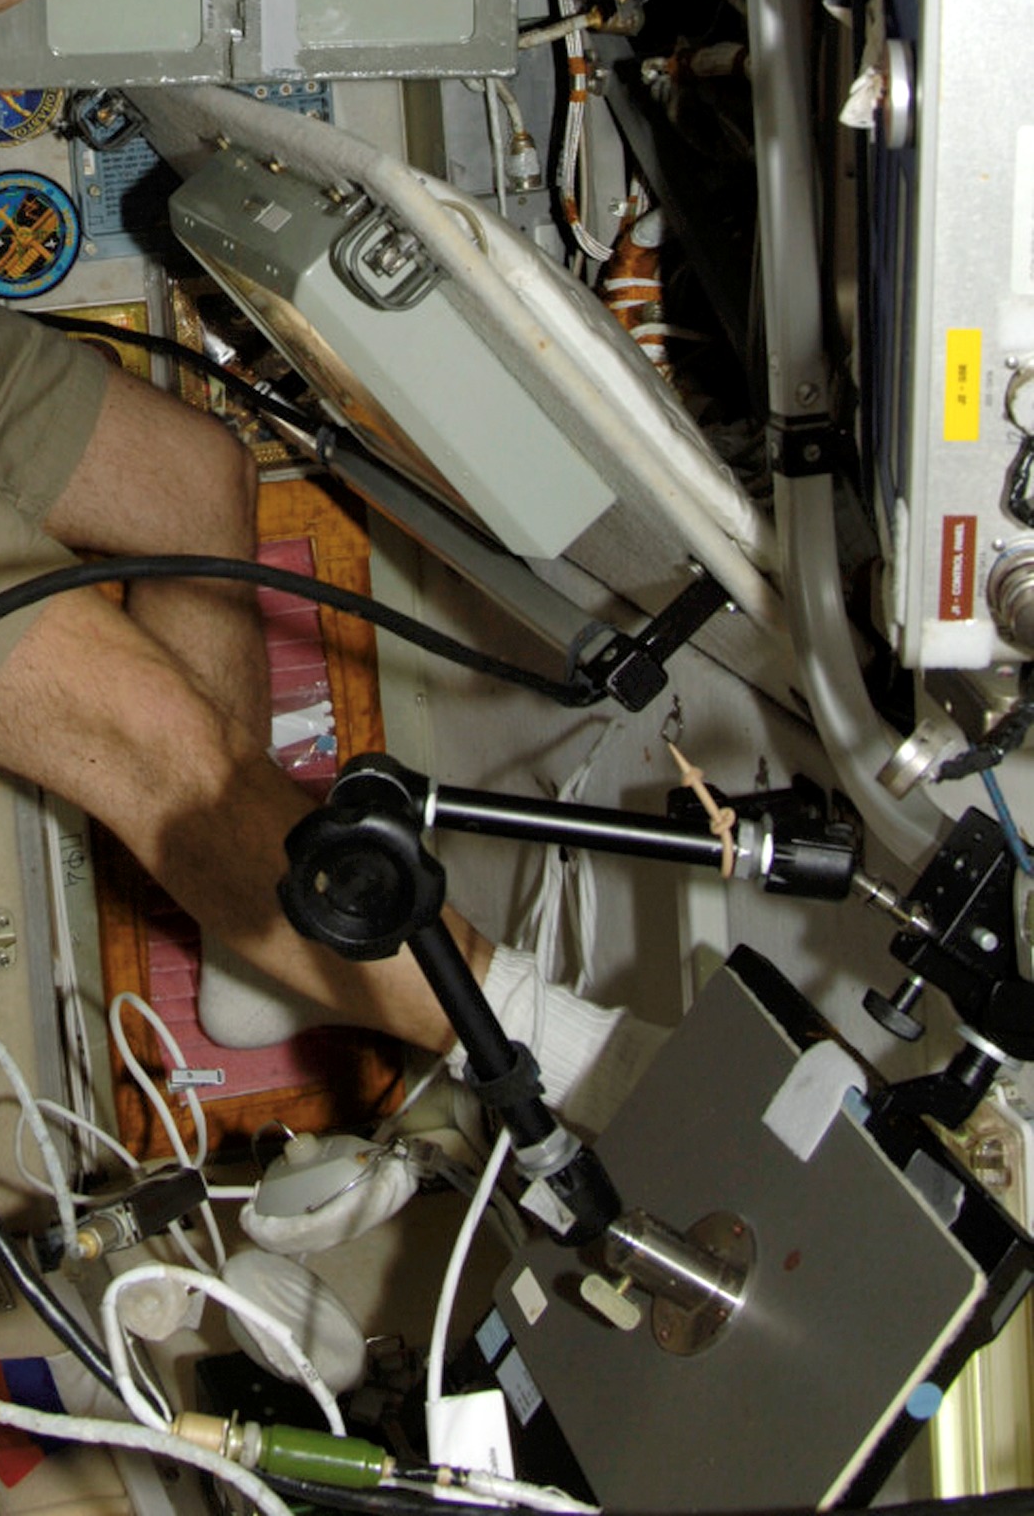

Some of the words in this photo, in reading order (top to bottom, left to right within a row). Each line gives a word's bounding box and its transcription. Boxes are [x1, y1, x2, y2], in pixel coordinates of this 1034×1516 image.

[953, 521, 965, 552] PANEL
[951, 553, 963, 596] CONTROL
[58, 833, 88, 888] ПФ4
